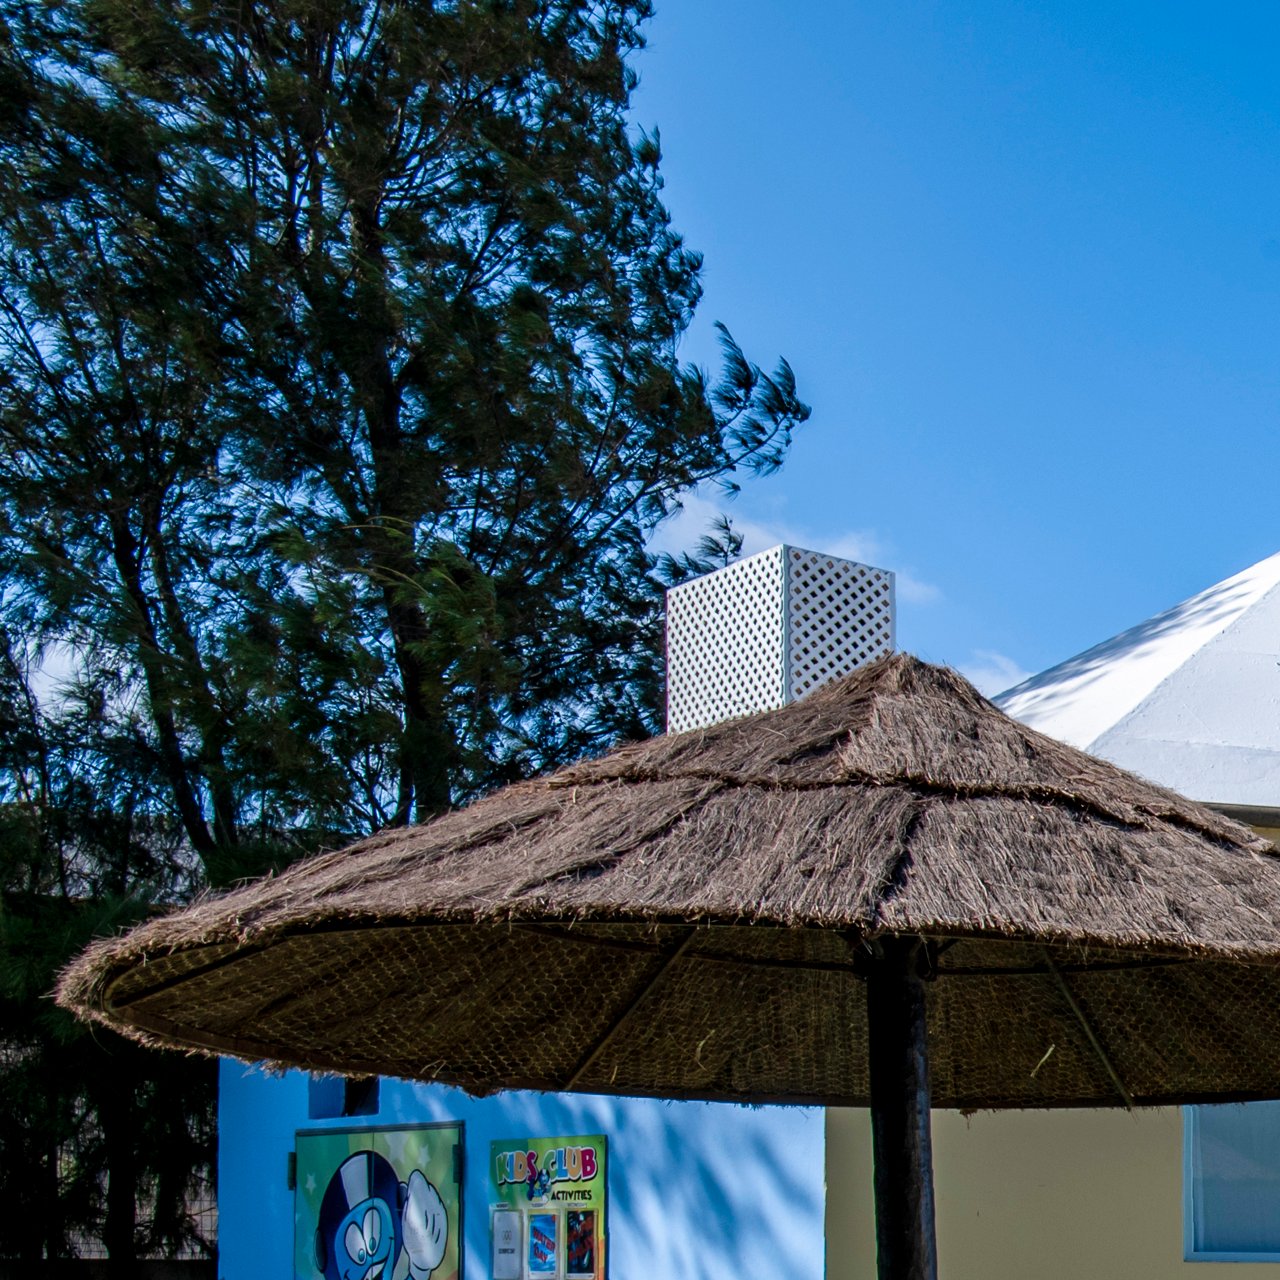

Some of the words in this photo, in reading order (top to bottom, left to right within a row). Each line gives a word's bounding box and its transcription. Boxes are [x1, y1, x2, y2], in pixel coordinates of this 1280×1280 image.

[496, 1150, 537, 1184] KIDS
[543, 1146, 598, 1182] CLUB
[551, 1190, 592, 1200] ACTIVITIES
